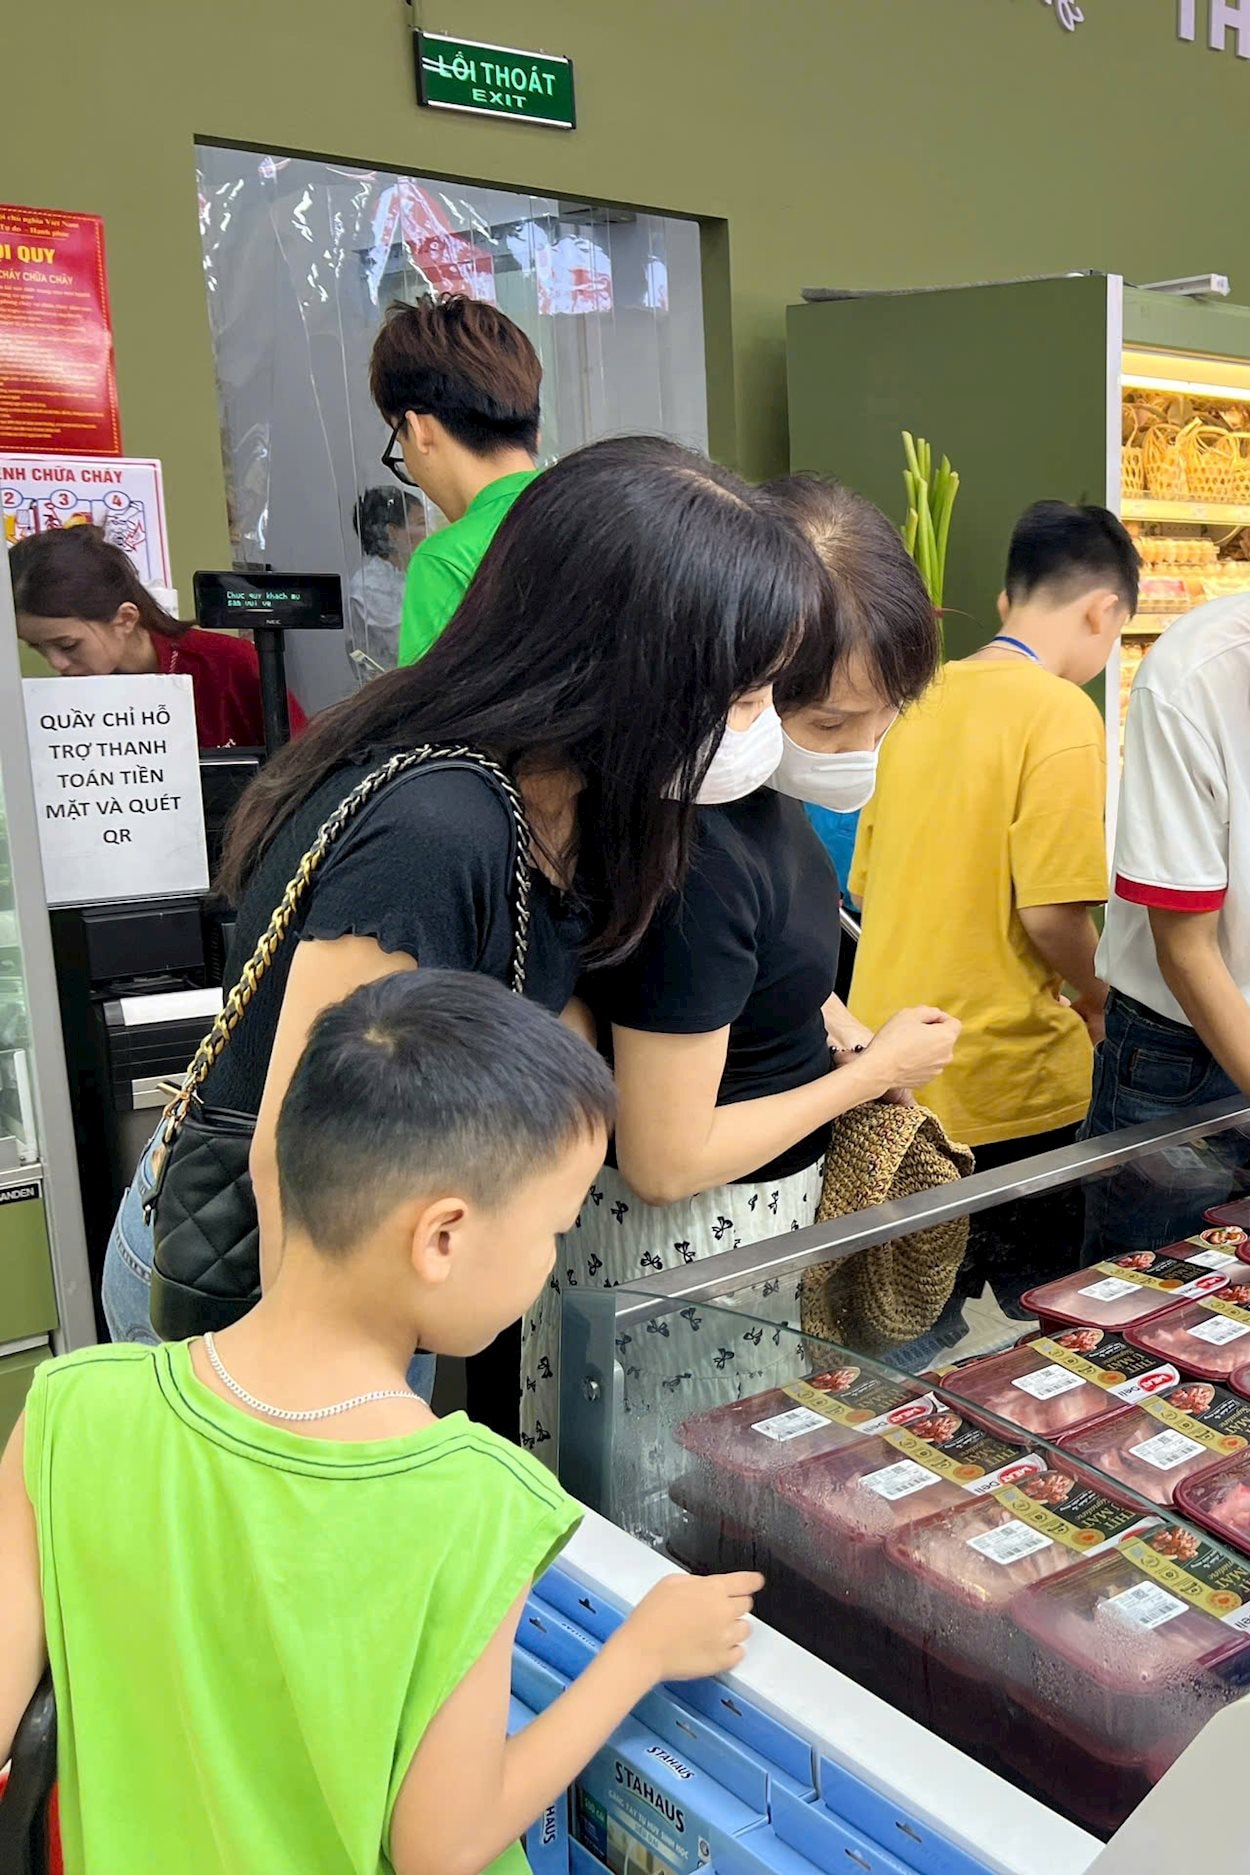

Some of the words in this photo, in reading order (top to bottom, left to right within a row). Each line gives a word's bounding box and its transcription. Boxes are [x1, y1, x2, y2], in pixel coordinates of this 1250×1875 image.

[479, 65, 556, 97] THOÁT
[472, 88, 527, 109] EXIT
[17, 245, 55, 264] QUY
[0, 467, 26, 480] NH
[32, 465, 75, 482] CHỮA
[81, 468, 122, 484] CHÁY
[4, 492, 14, 504] 2
[59, 493, 69, 506] 3
[40, 708, 95, 731] QUẦY
[103, 706, 134, 727] CHỈ
[142, 704, 171, 725] HỖ
[48, 743, 92, 761] TRỢ
[97, 740, 167, 757] THANH
[58, 769, 114, 788] TOÁN
[120, 765, 164, 784] TIỀN
[46, 800, 90, 820] MẶT
[96, 797, 123, 815] VÀ
[129, 793, 181, 814] QUÉT
[103, 829, 132, 844] QR
[0, 1187, 35, 1201] ANDEN
[647, 1746, 694, 1779] STAHAUS
[615, 1760, 686, 1833] STAHAUS
[543, 1805, 556, 1845] HAUS
